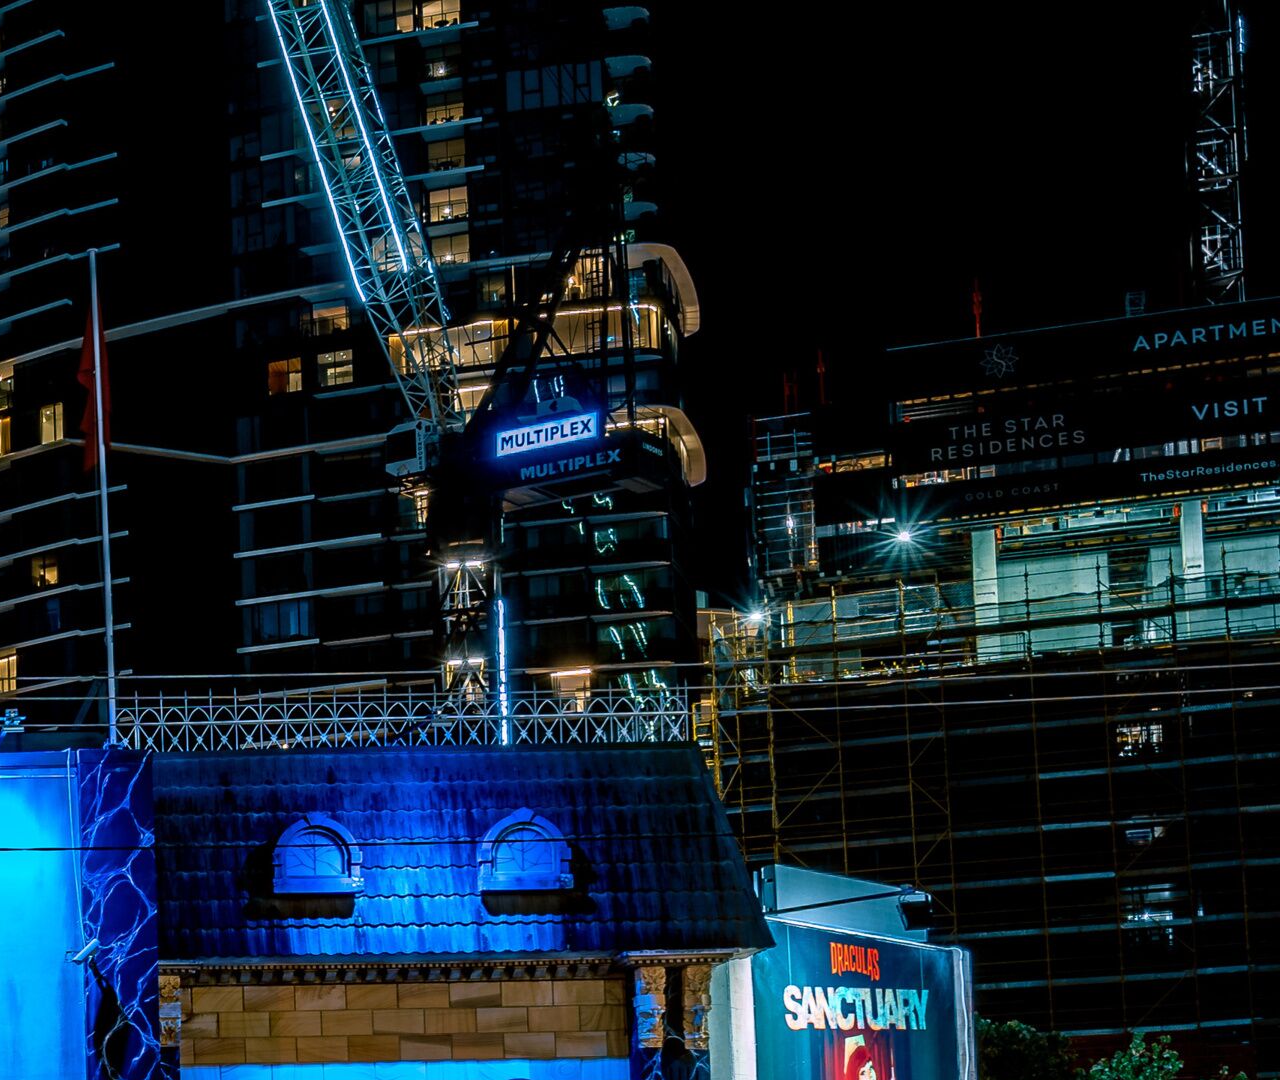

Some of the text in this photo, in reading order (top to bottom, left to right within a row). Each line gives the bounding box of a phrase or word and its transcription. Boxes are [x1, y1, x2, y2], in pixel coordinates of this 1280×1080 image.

[1191, 396, 1268, 420] VISIT
[499, 417, 593, 451] MULTIPLEX
[948, 413, 1065, 440] THE STAR
[931, 429, 1086, 462] RESIDENCES
[520, 448, 622, 481] MULTIPLEX
[965, 483, 1060, 502] GOLD COAST
[828, 941, 880, 981] DRACULA'S
[782, 984, 929, 1031] SANCTUARY
